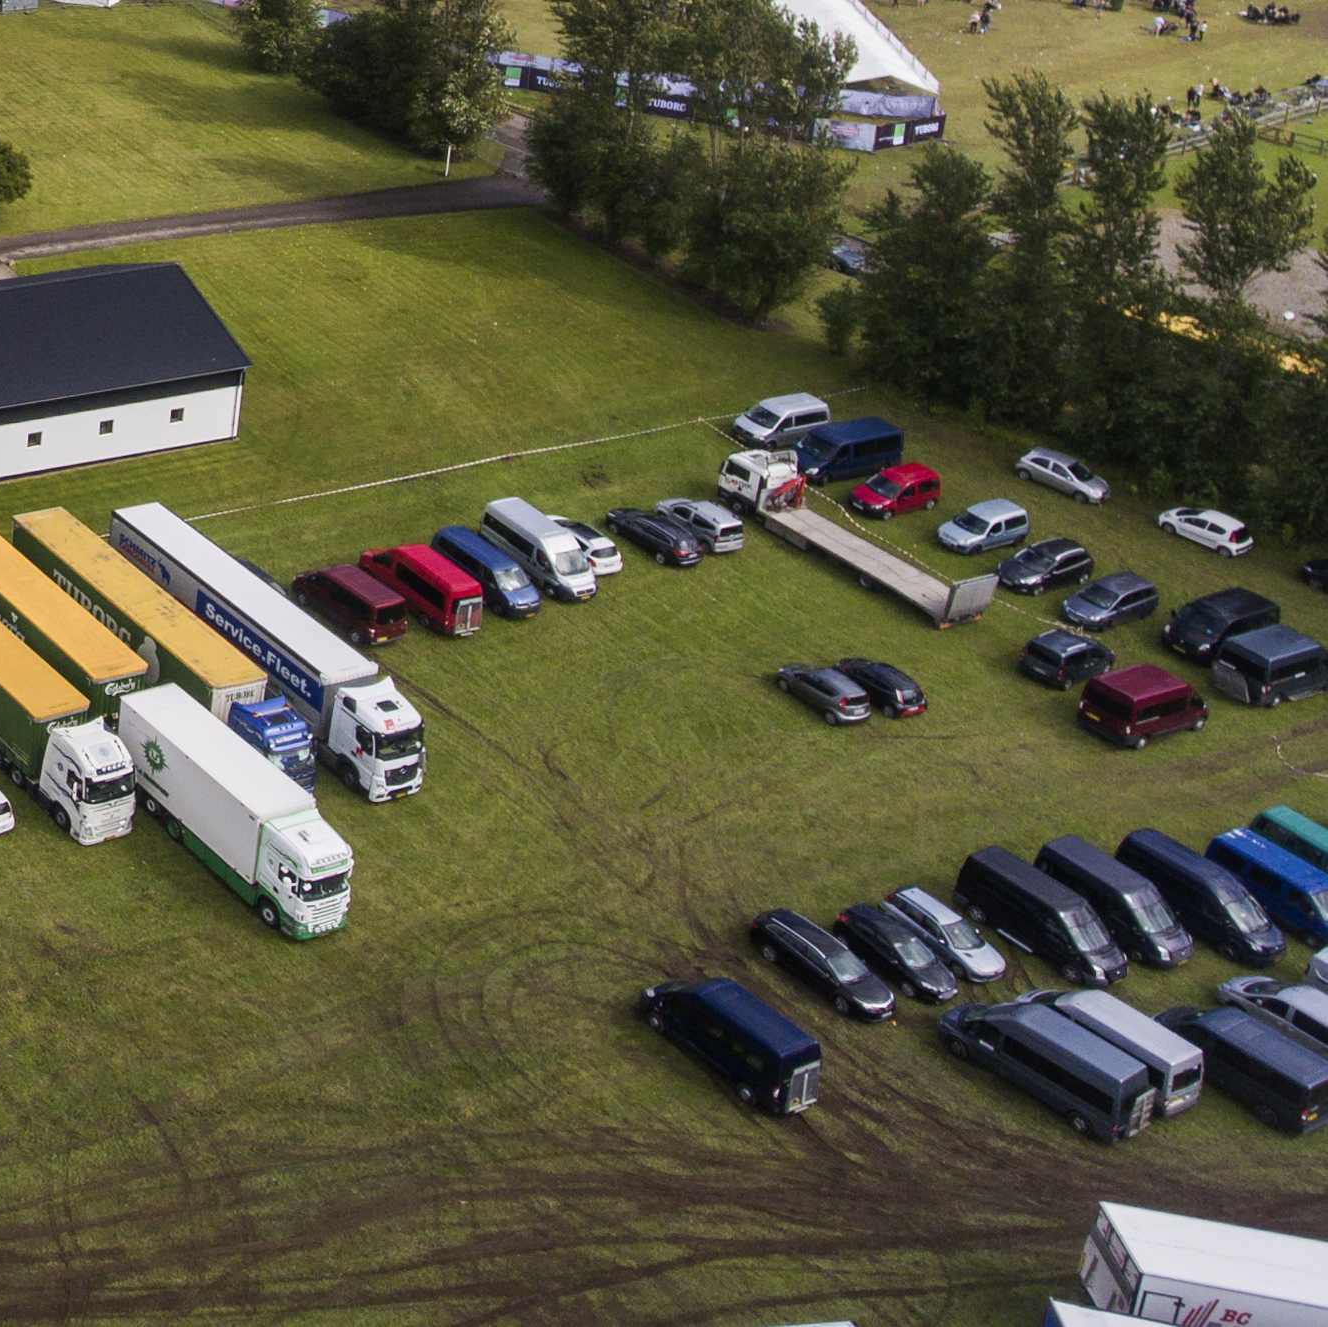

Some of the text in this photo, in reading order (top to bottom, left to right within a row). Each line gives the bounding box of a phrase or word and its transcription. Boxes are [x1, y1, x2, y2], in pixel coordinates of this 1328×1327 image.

[648, 98, 687, 112] TUBORG
[119, 533, 157, 569] SCHMITZ
[205, 602, 312, 698] Service.Fleet.
[105, 679, 136, 696] Carlsberg
[1220, 1309, 1253, 1325] BC
